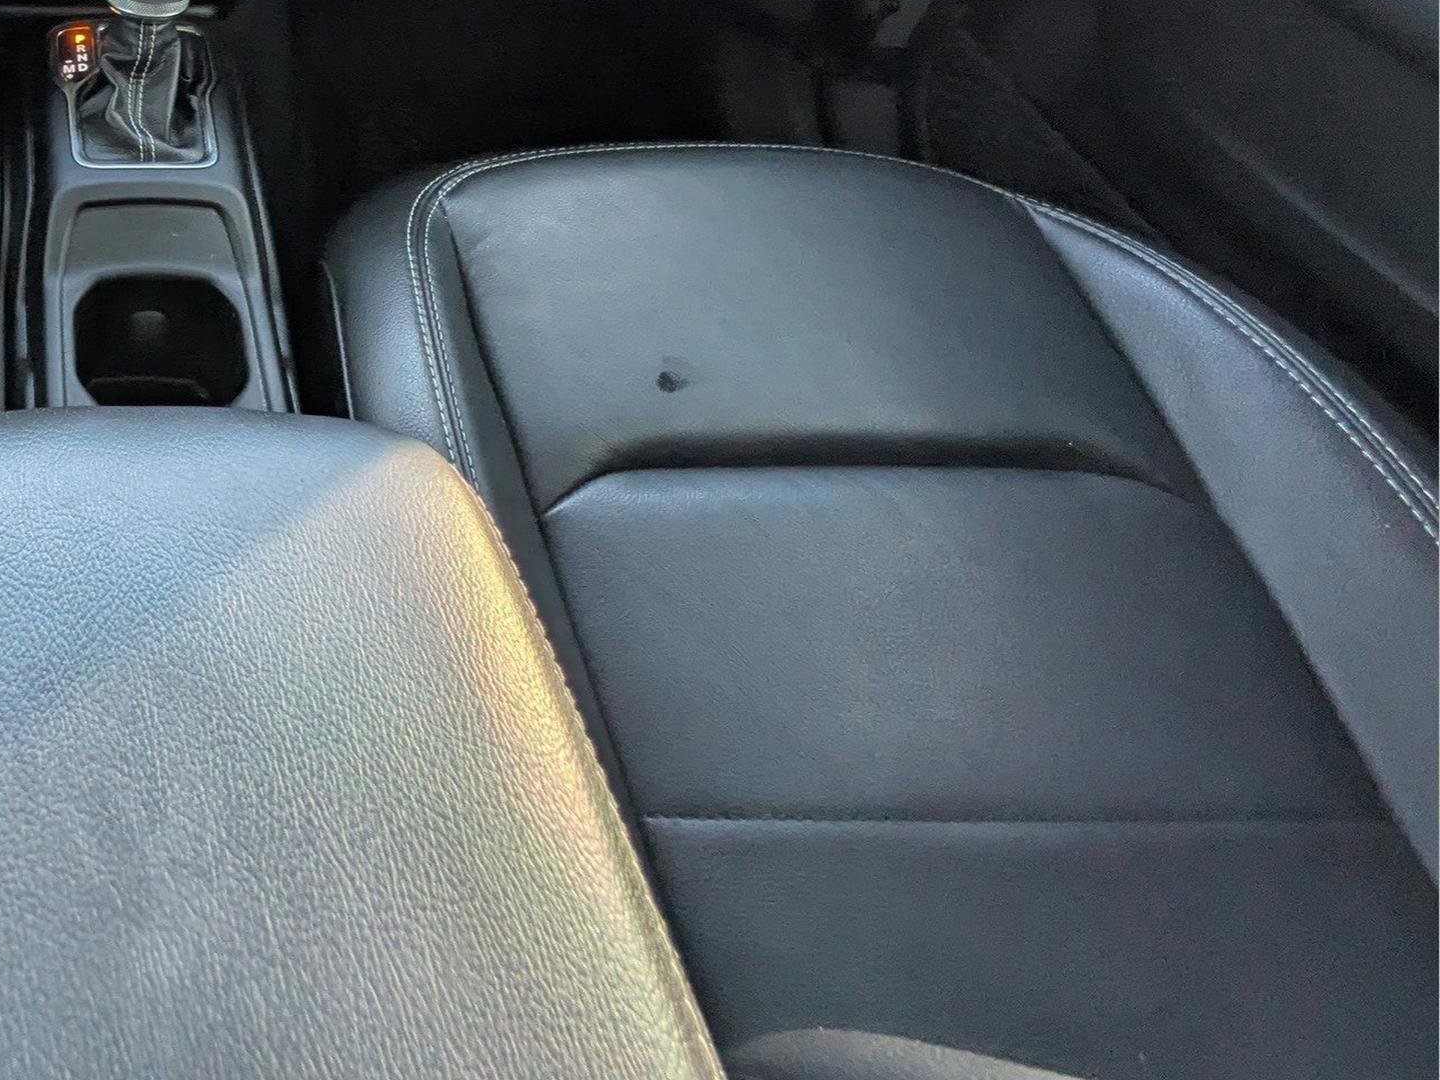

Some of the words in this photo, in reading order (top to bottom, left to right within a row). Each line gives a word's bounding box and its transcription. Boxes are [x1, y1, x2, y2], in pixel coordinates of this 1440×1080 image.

[75, 34, 86, 44] P
[76, 44, 86, 53] R
[77, 53, 88, 62] N
[63, 64, 76, 74] M
[78, 63, 89, 72] D
